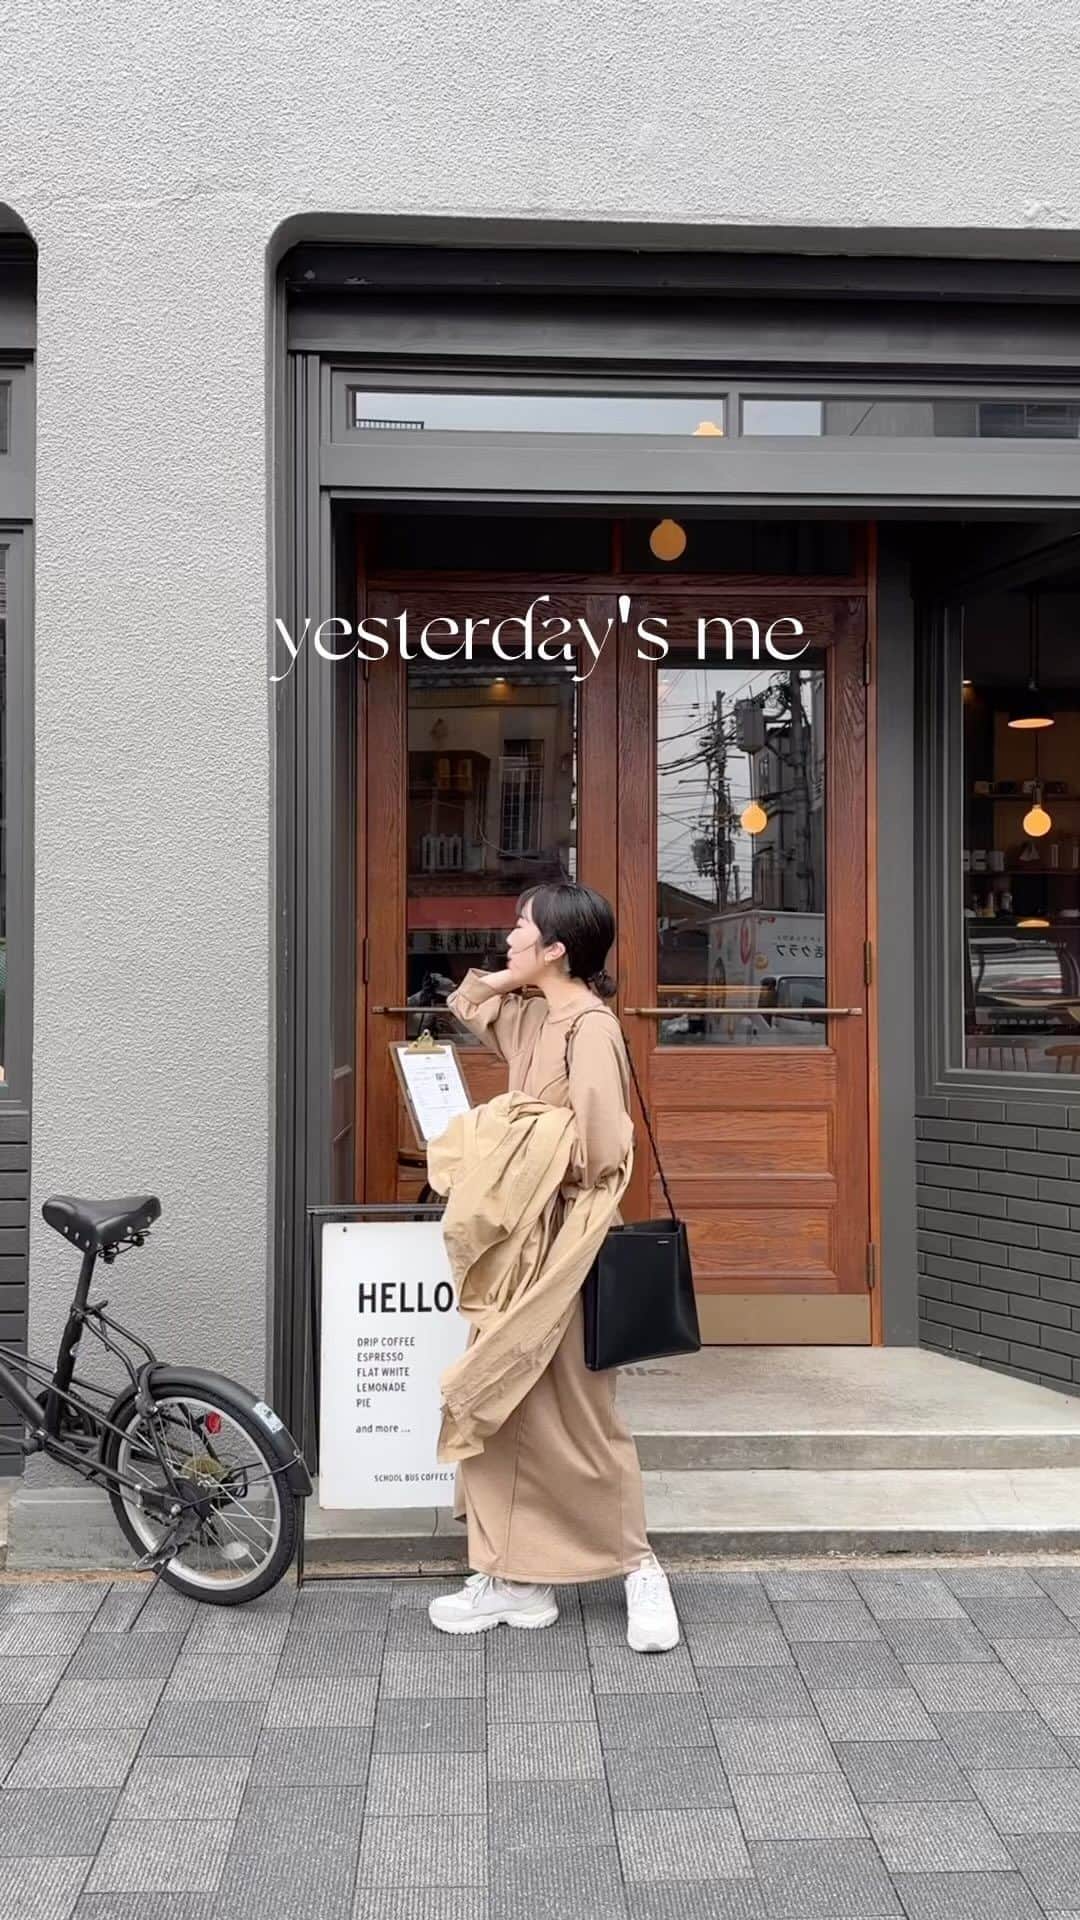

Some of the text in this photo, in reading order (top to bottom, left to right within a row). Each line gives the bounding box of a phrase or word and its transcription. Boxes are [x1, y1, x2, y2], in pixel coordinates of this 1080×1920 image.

[357, 1336, 415, 1347] DRIP COFFEE
[357, 1352, 404, 1361] ESPRESSO
[357, 1367, 410, 1377] FLAT WHITE
[357, 1382, 406, 1392] LEMONADE
[356, 1398, 371, 1408] PIE
[356, 1424, 373, 1433] and
[374, 1474, 402, 1482] SCHOOL
[405, 1473, 419, 1481] BUS
[421, 1473, 449, 1481] COFFEE
